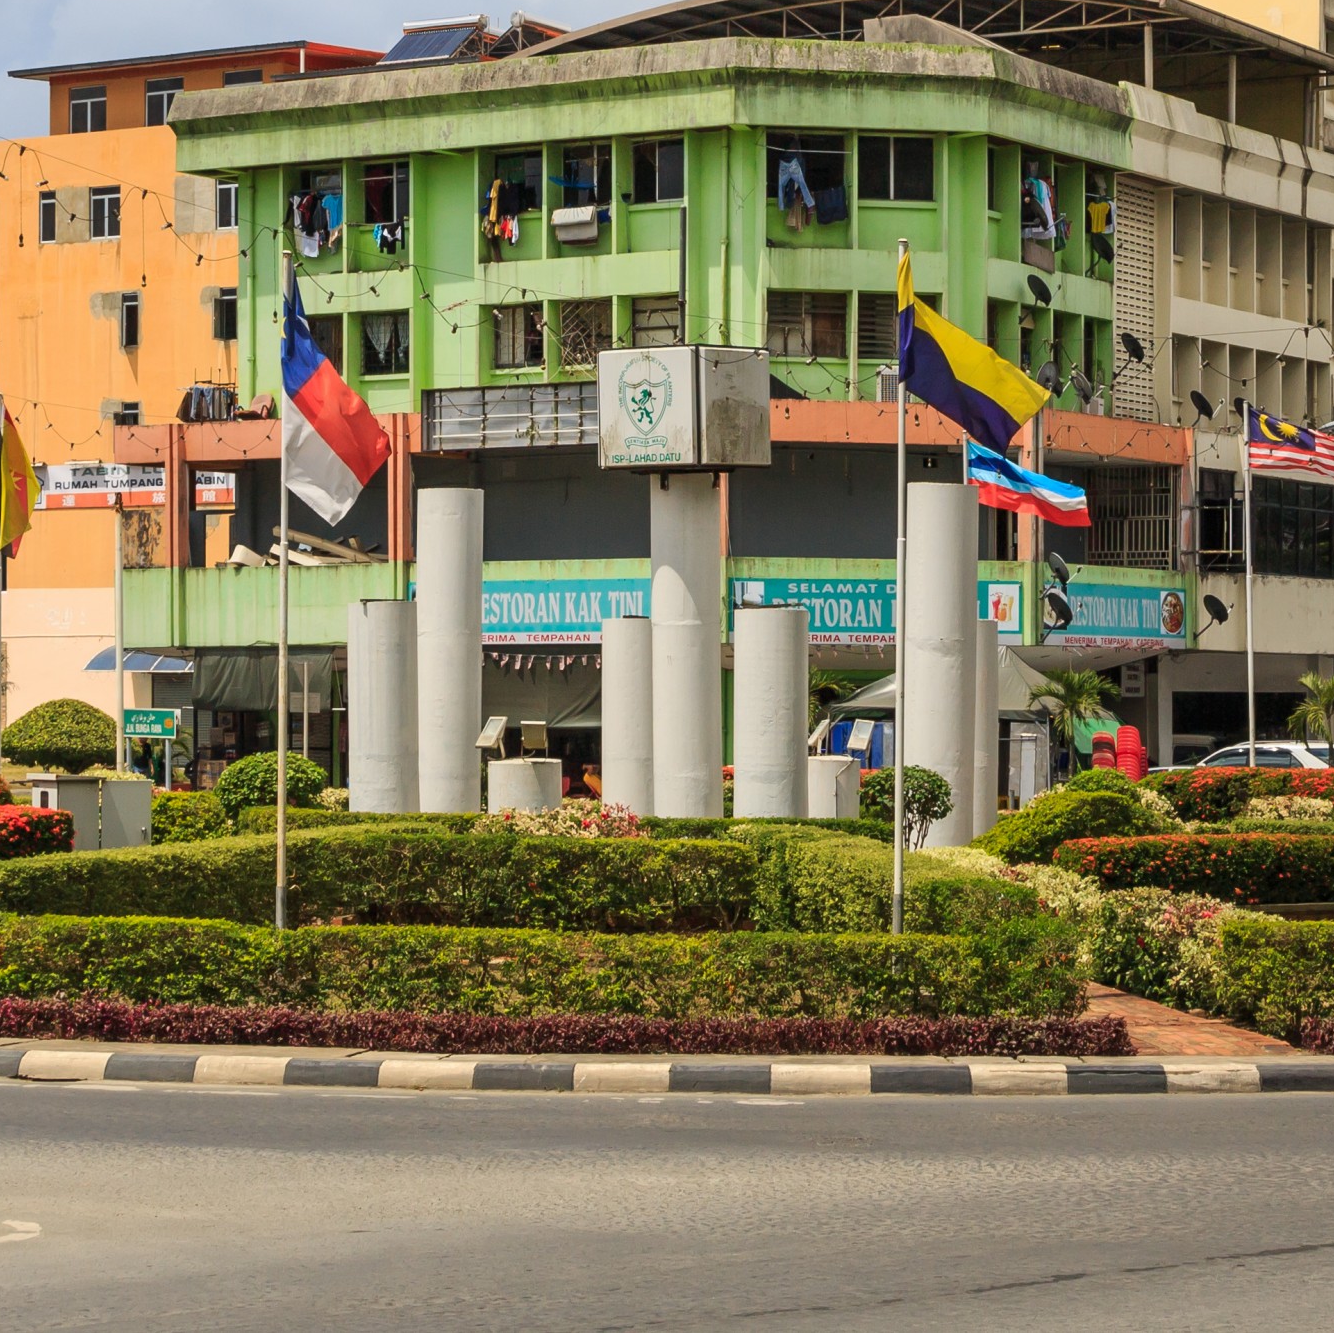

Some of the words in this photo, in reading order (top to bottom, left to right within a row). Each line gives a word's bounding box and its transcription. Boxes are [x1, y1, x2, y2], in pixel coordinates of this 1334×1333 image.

[611, 453, 657, 464] ISP-LAHAD
[659, 452, 681, 462] DATU
[70, 466, 130, 477] TABIN
[54, 480, 98, 490] RUMAH
[104, 478, 164, 489] TUMPANG
[196, 475, 226, 485] ABIN
[787, 583, 878, 594] SELAMAT
[481, 591, 560, 624] ESTORAN
[564, 591, 602, 624] KAK
[607, 590, 644, 619] TINI
[1070, 595, 1118, 628] RESTORAN
[1120, 598, 1140, 628] KAK
[1142, 599, 1159, 629] TINI
[526, 633, 591, 643] TEMPAHAN
[1064, 636, 1097, 645] MENERIMA
